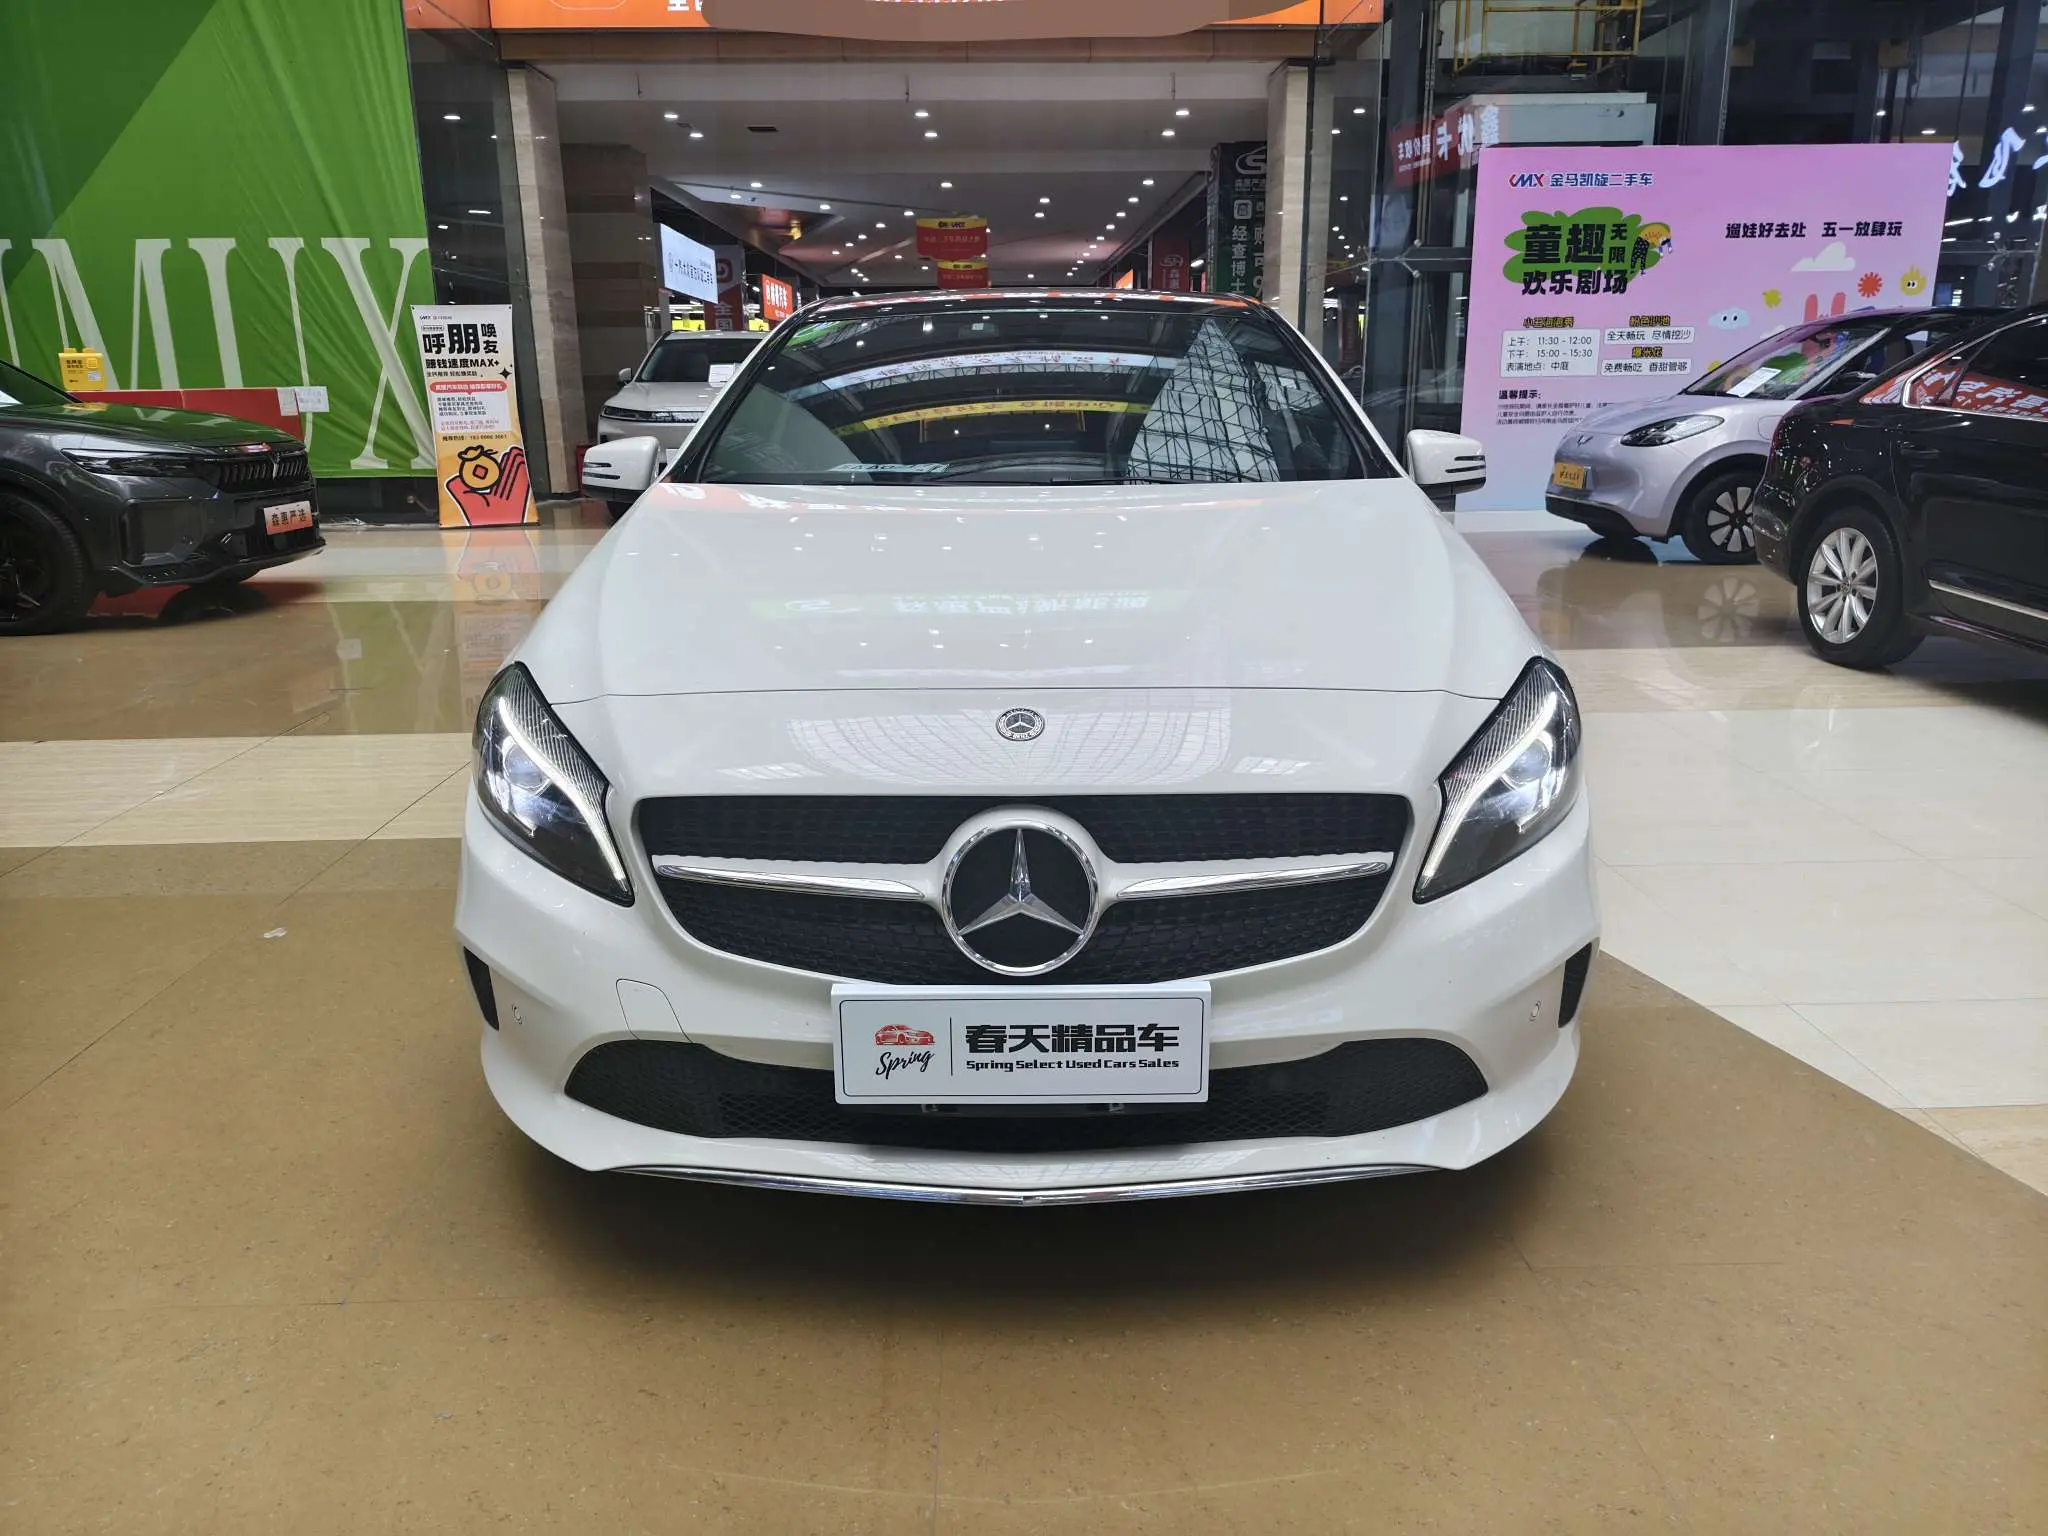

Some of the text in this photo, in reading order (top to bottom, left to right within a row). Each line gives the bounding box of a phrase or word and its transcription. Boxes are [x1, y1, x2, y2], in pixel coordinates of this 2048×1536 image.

[1550, 173, 1653, 187] 金马凯旋二手车
[1725, 221, 1902, 238] 遛娃好去处 五一放肆玩
[1522, 269, 1628, 295] 欢乐剧场
[1607, 330, 1645, 341] 全天畅玩
[965, 1023, 1180, 1054] 春天精品车
[875, 1048, 936, 1080] Spring
[966, 1058, 1180, 1073] Spring Select Used Cars Sales
